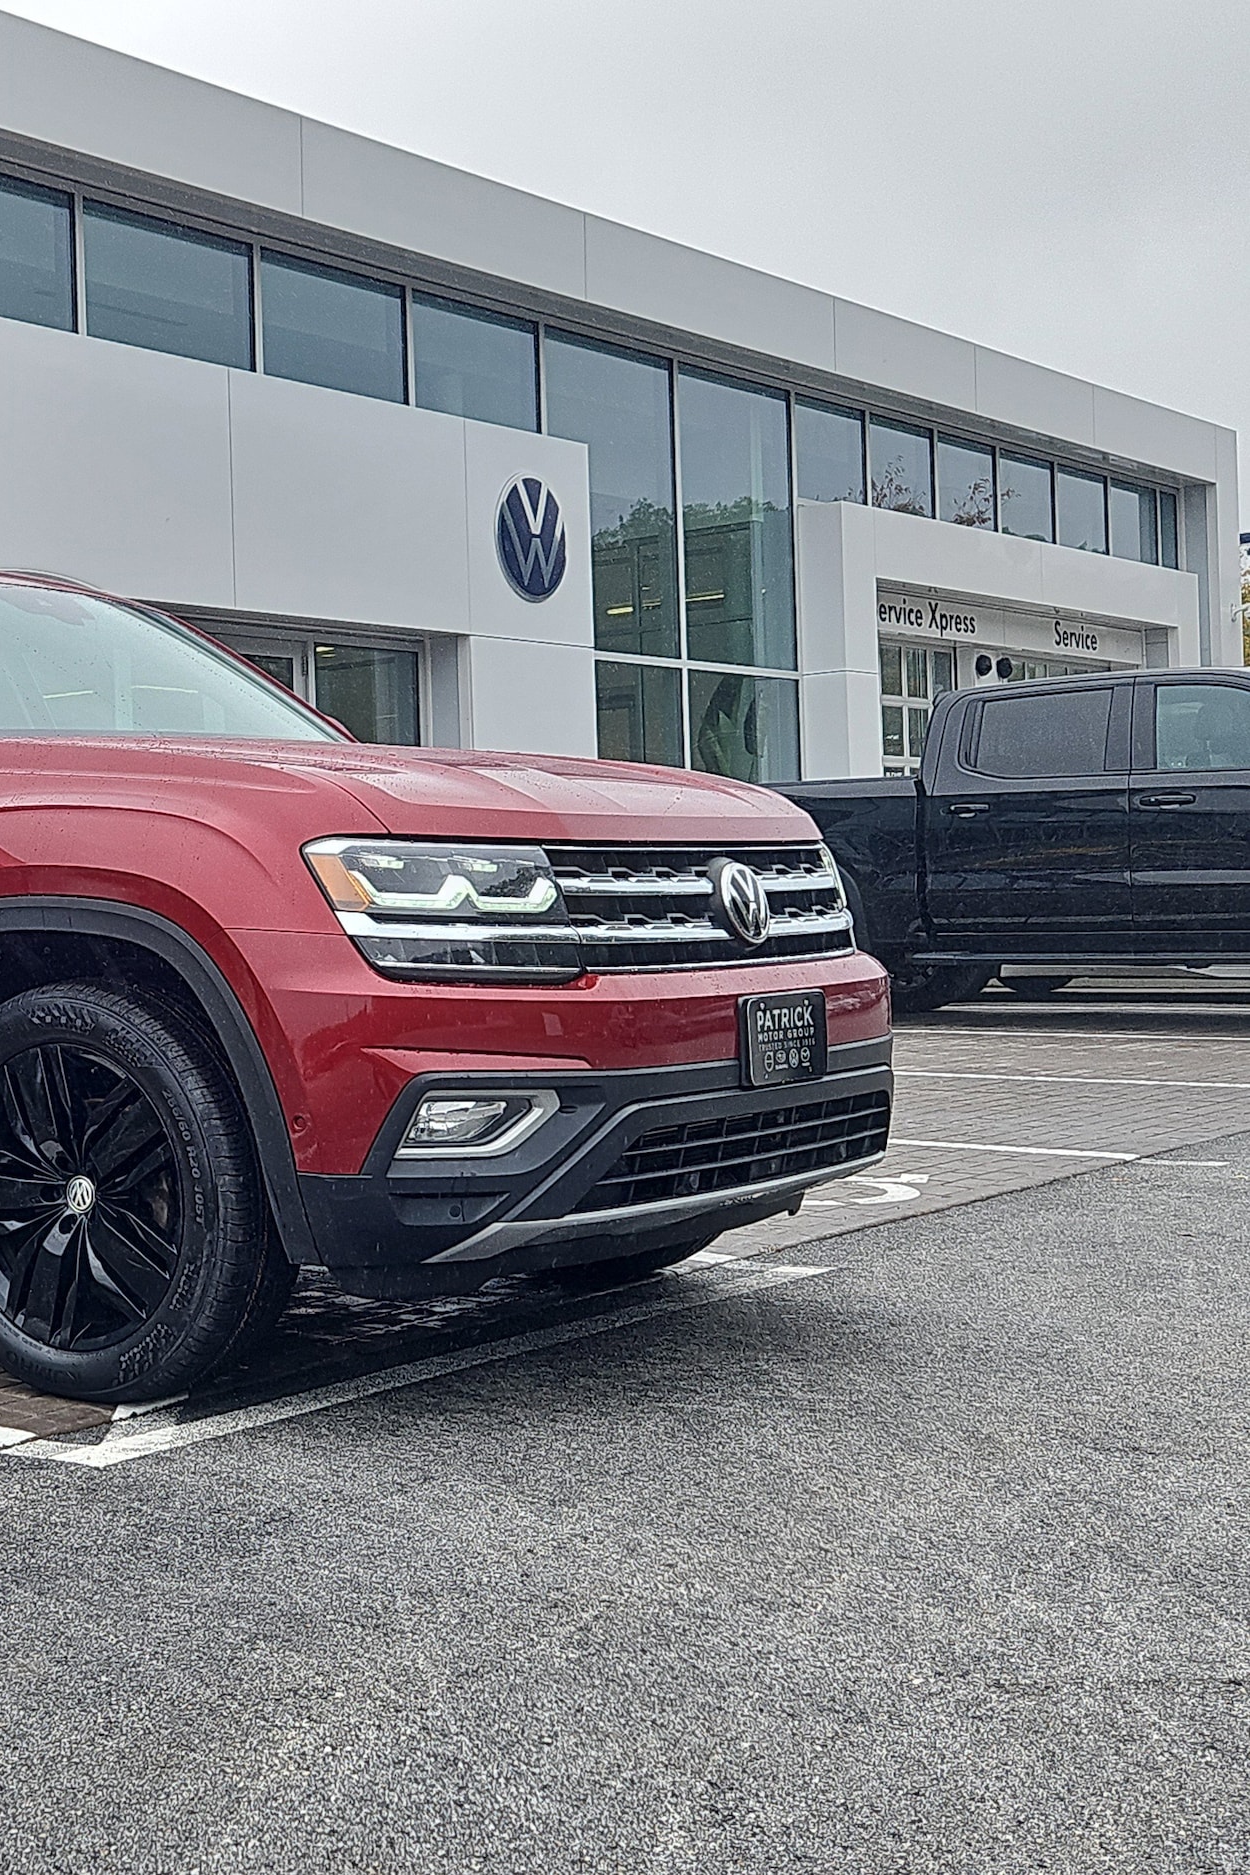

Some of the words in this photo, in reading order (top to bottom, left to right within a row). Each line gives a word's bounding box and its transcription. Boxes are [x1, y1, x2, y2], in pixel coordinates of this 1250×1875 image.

[878, 598, 923, 627] ervice
[928, 602, 976, 637] Xpress
[1054, 620, 1098, 651] Service
[756, 1005, 814, 1032] PATRICK
[758, 1030, 784, 1043] MOTOR
[787, 1027, 815, 1039] GROUP
